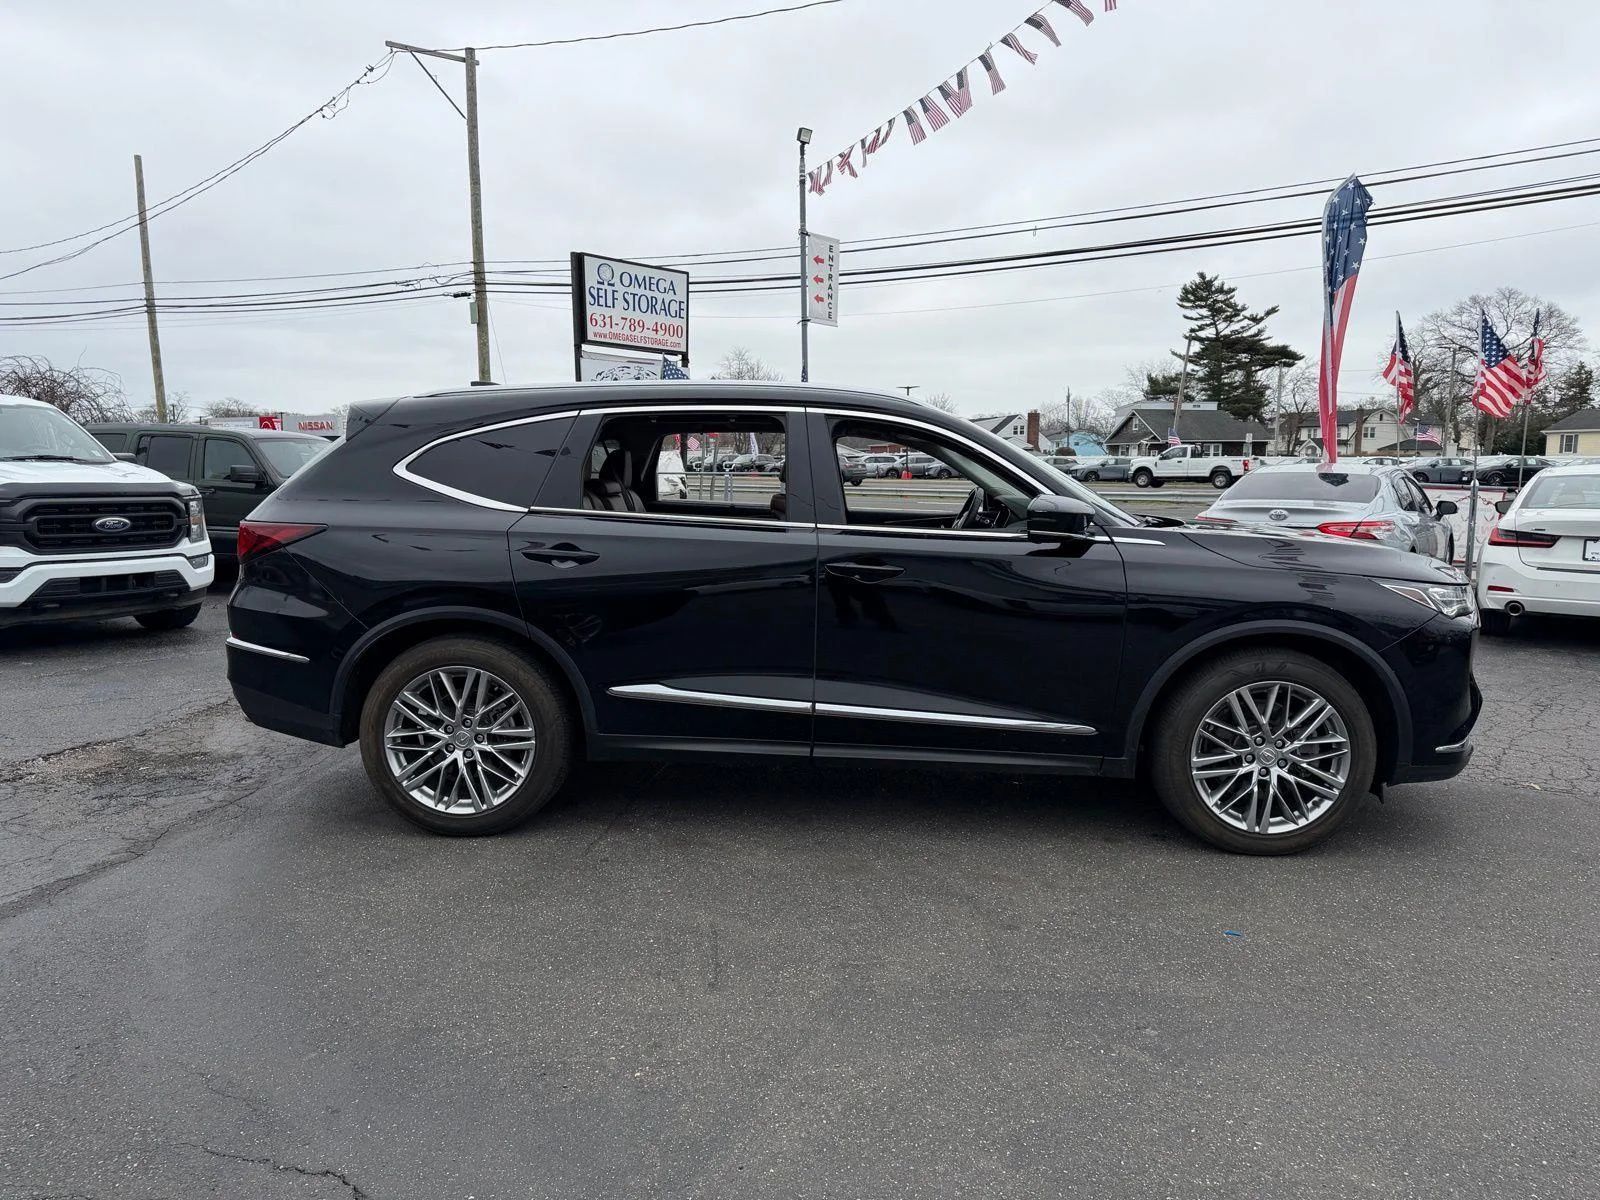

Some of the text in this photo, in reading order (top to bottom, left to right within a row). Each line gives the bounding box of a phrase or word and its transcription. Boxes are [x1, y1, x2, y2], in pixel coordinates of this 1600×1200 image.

[620, 271, 677, 296] OMEGA
[588, 285, 685, 319] SELF STORAGE
[589, 312, 684, 339] 631-789-4900
[298, 421, 333, 431] NISSAN
